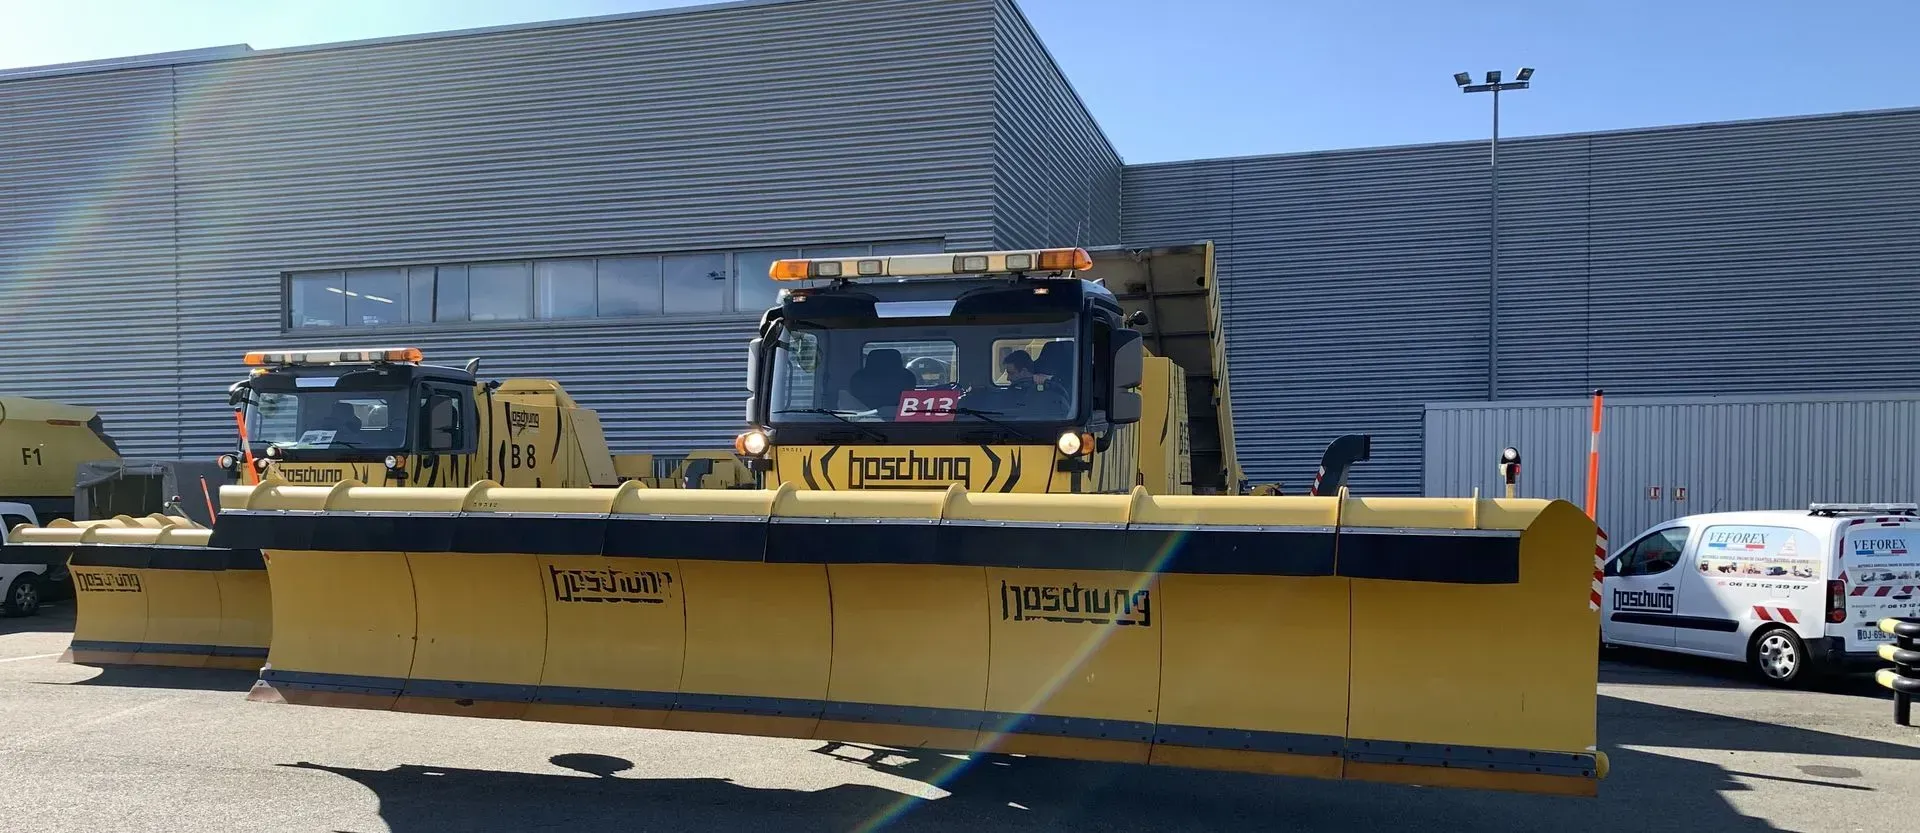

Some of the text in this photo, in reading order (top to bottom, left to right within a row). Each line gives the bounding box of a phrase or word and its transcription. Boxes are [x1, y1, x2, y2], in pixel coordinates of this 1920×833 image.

[899, 397, 954, 417] B13
[21, 447, 42, 466] F1
[511, 443, 537, 469] B 8
[848, 449, 970, 490] boschung
[1708, 531, 1769, 545] VEFOREX
[1853, 538, 1906, 550] VEFOREX
[1613, 587, 1673, 614] boschung
